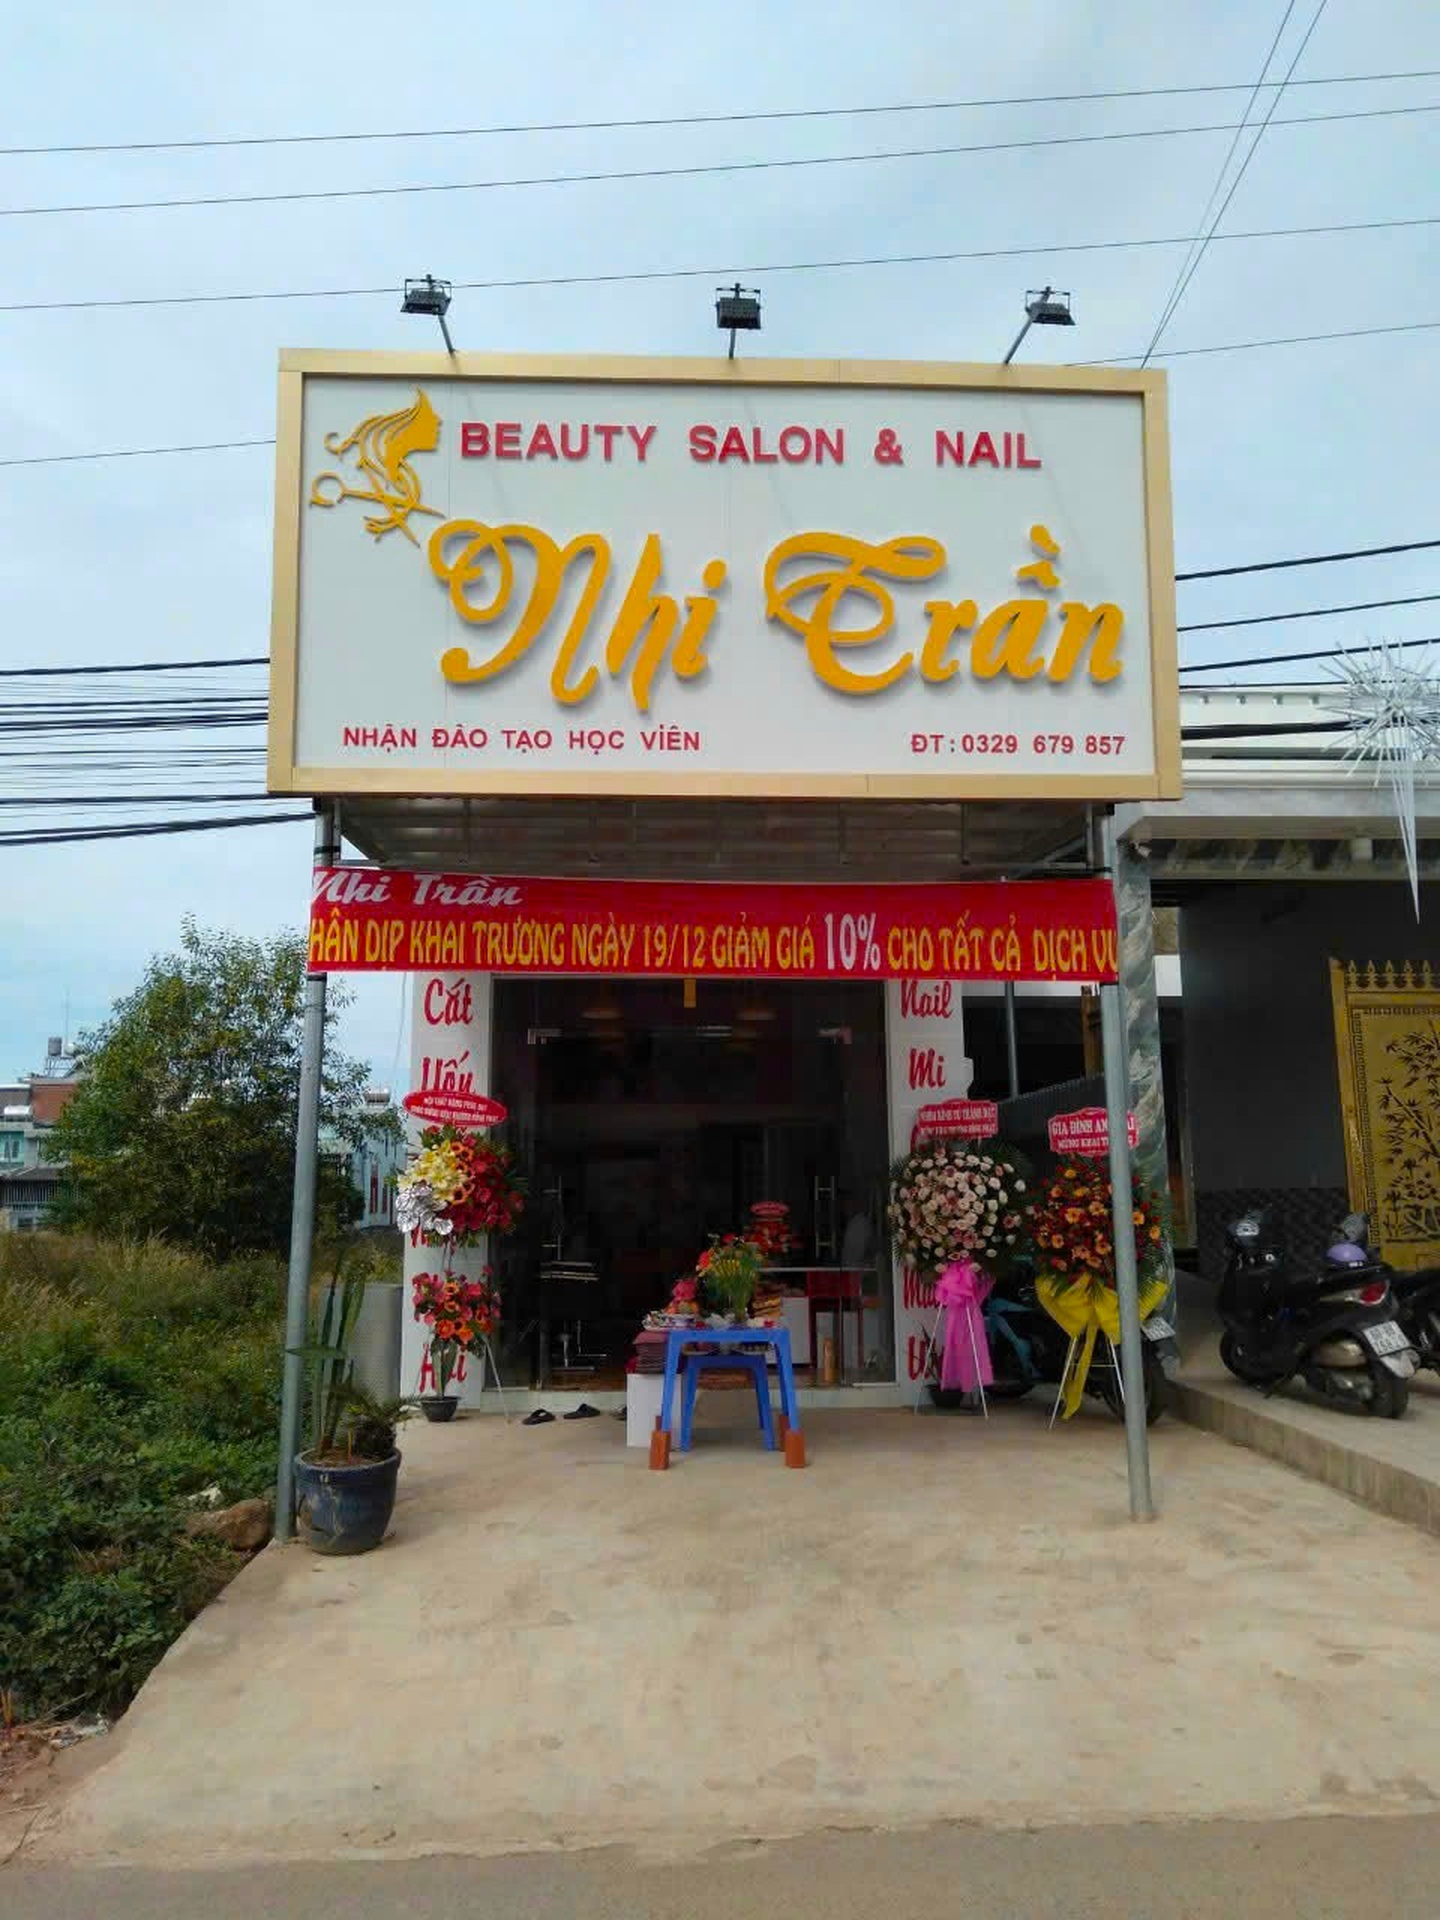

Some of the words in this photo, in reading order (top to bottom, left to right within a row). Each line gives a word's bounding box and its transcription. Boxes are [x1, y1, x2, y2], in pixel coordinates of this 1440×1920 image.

[460, 422, 657, 461] BEAUTY
[688, 425, 845, 465] SALON
[873, 428, 904, 465] &
[935, 430, 1042, 470] NAIL
[428, 519, 727, 713] Nhi
[343, 723, 418, 754] NHẬN
[501, 729, 553, 754] TẠO
[568, 729, 625, 756] HỌC
[961, 734, 1019, 754] 0329
[1033, 735, 1075, 755] 679
[1085, 735, 1126, 755] 857
[413, 874, 524, 907] Trần
[310, 906, 359, 963] HÂN
[364, 918, 405, 970] DỊP
[409, 919, 466, 964] KHAI
[571, 911, 635, 967] NGÀY
[643, 923, 706, 968] 19/12
[711, 911, 771, 970] GIẢM
[776, 914, 816, 970] GIÁ
[824, 912, 881, 972] 10%
[887, 926, 934, 972] CHO
[938, 909, 985, 972] TẤT
[990, 912, 1021, 972] CẢ
[1033, 929, 1087, 981] DỊCH
[901, 978, 952, 1019] Nail
[909, 1048, 946, 1090] Mi
